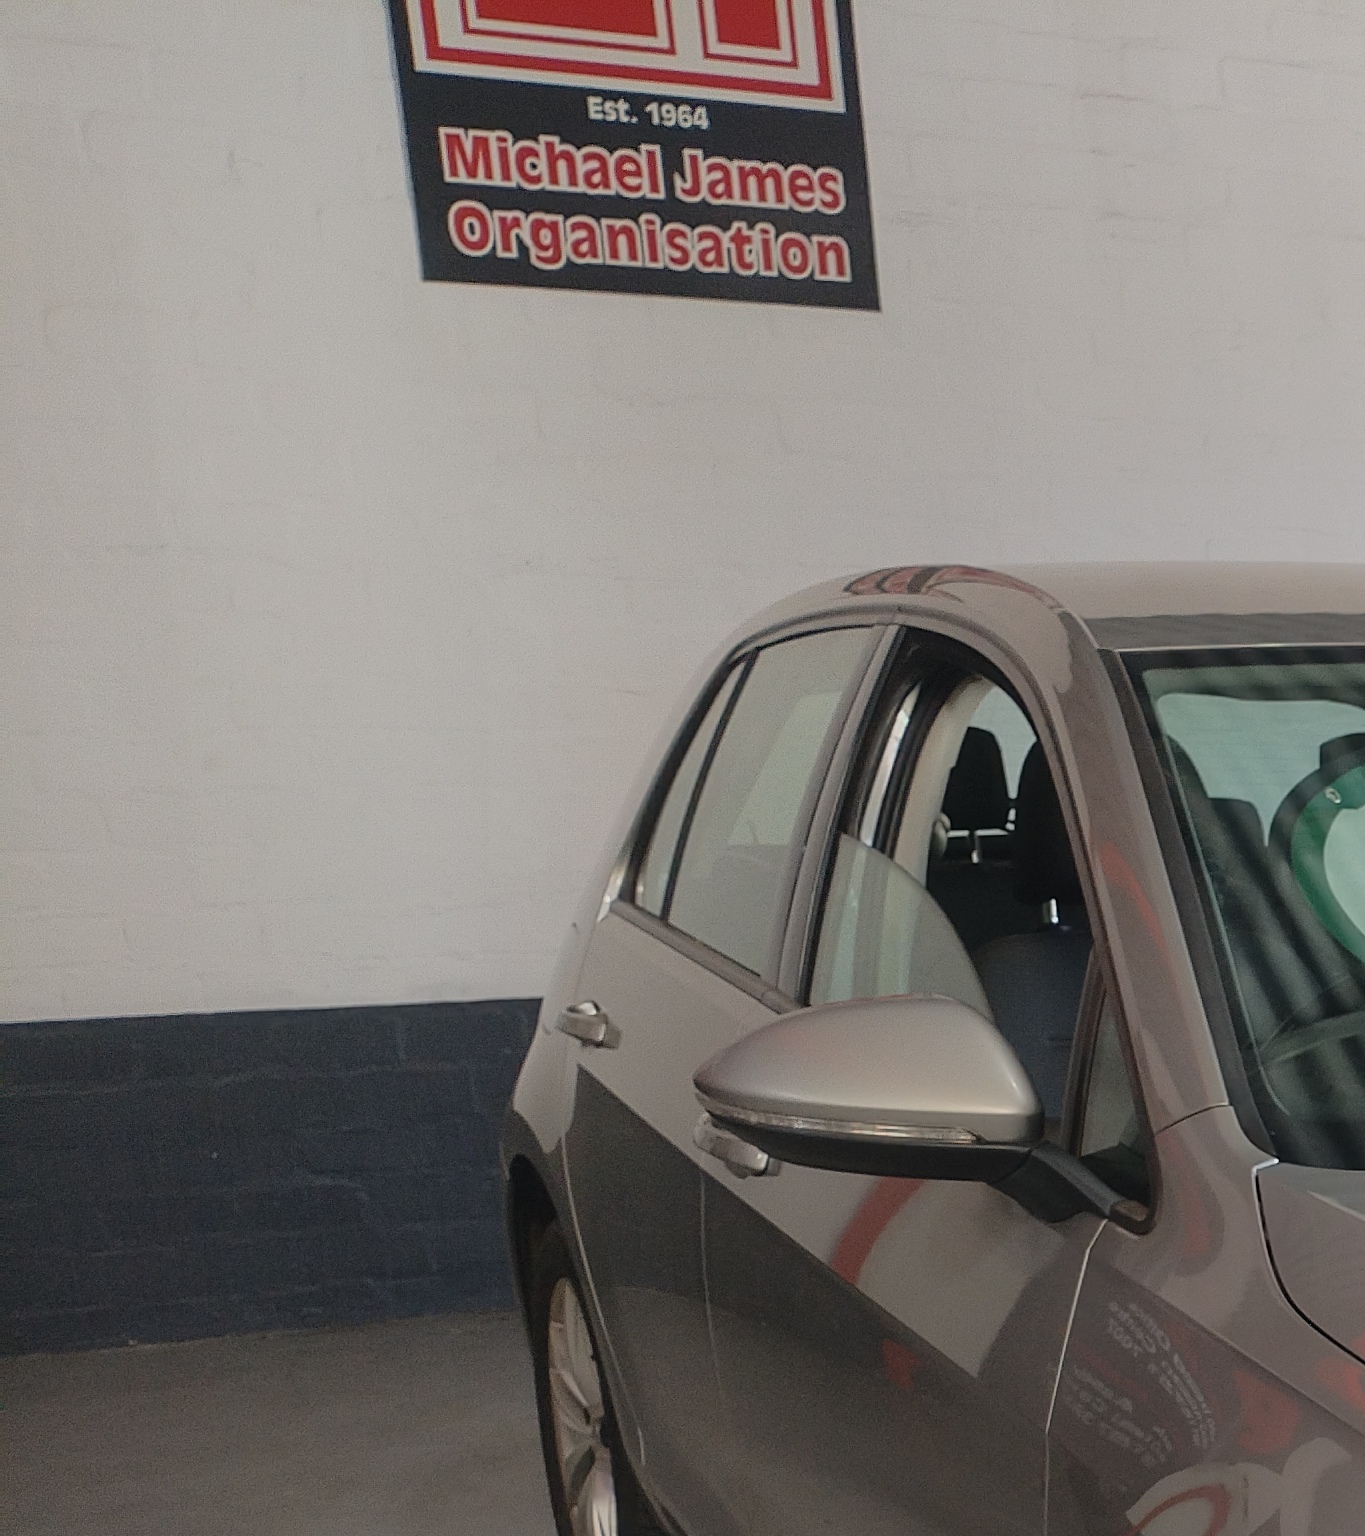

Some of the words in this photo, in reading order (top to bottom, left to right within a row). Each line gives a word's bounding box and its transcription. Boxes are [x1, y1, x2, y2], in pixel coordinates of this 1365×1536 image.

[586, 96, 639, 125] Est.
[645, 102, 710, 130] 1964
[439, 126, 664, 199] Michael
[673, 145, 844, 215] James
[447, 200, 852, 283] Organisation
